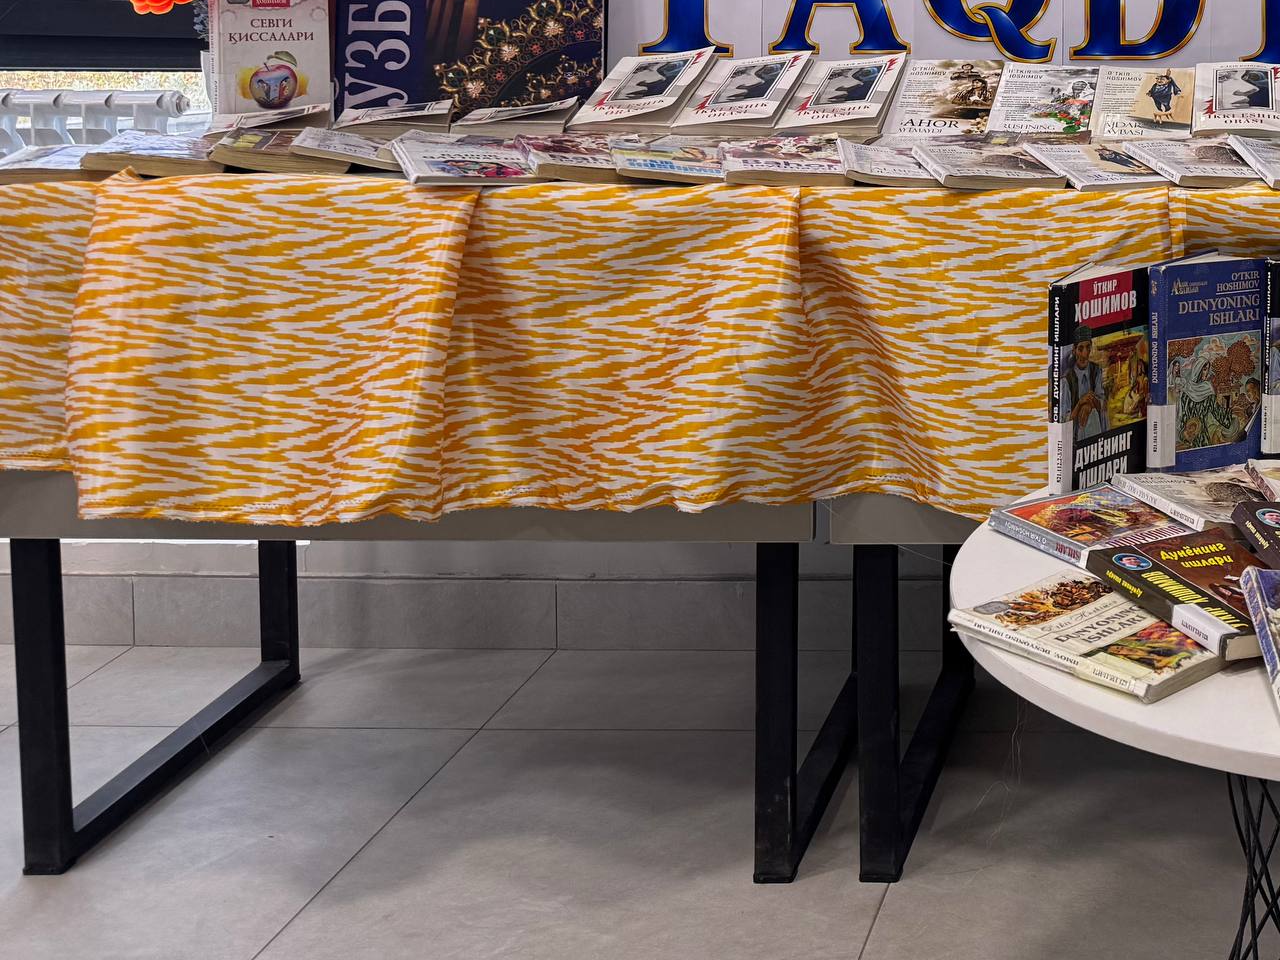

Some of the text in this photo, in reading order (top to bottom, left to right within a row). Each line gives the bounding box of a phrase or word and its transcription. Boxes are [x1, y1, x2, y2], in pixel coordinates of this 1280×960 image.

[250, 18, 293, 28] СЕВГИ
[228, 31, 315, 45] ҚИССАЛАРИ
[900, 118, 960, 129] AHOR
[1093, 278, 1118, 296] ЎТКИР
[1216, 279, 1260, 292] HOSHIMOV
[1178, 294, 1260, 315] DUNYONING
[1209, 308, 1260, 326] ISHLARI
[1074, 431, 1133, 472] ДУНЁНИНГ
[1078, 456, 1128, 490] ИШЛАРИ
[1055, 542, 1081, 561] SHLARI
[1160, 542, 1227, 562] Дунёнинг
[1182, 554, 1233, 569] ишлари
[1081, 614, 1147, 644] ISHLARI
